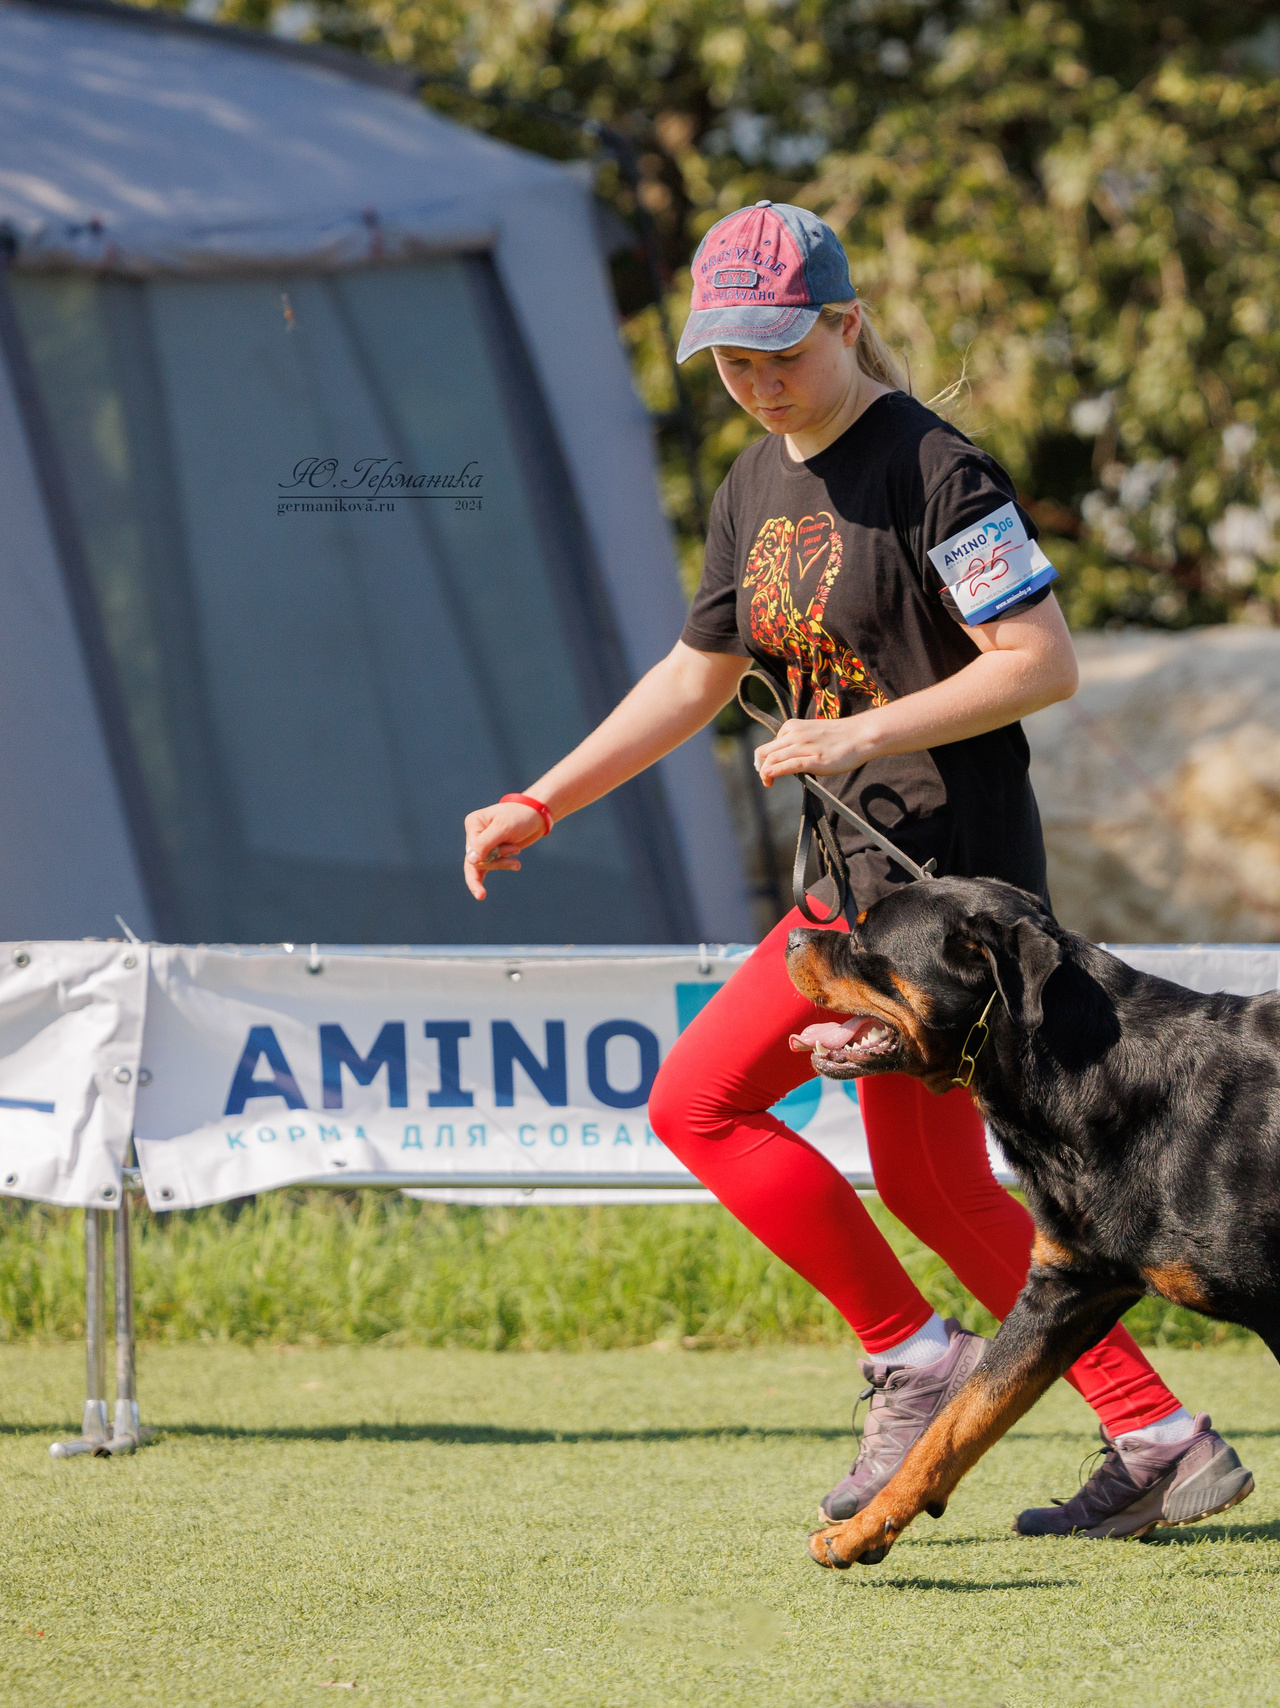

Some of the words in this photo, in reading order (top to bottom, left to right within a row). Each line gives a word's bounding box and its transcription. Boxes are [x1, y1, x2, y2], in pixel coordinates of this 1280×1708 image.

[719, 272, 750, 284] NYS
[968, 540, 1012, 597] 25
[226, 1123, 368, 1149] КОРМА
[401, 1123, 487, 1150] ДЛЯ
[518, 1122, 664, 1147] СОБАК
